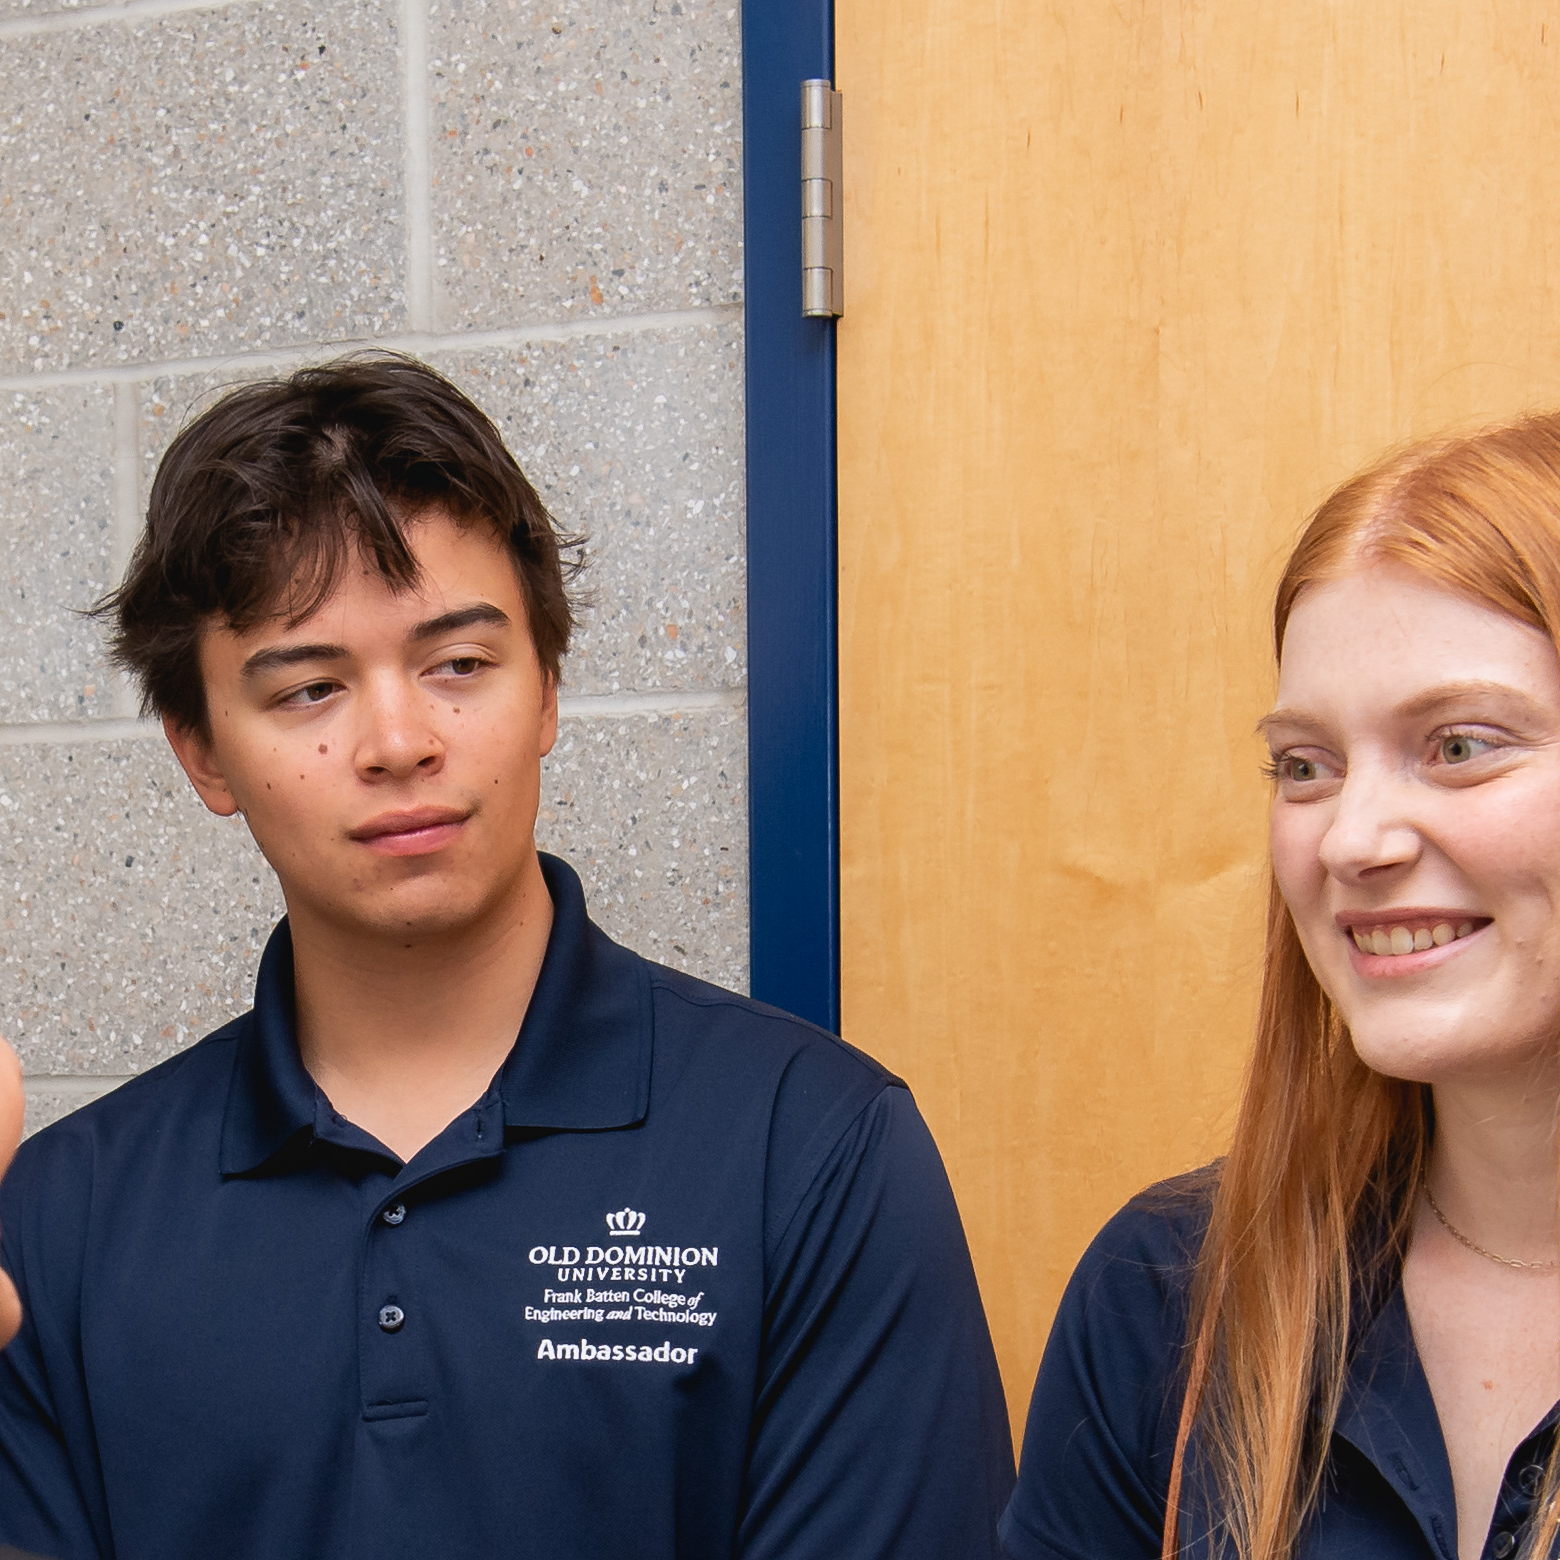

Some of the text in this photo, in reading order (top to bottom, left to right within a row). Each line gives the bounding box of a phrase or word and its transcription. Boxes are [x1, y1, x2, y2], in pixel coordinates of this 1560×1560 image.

[528, 1246, 719, 1266] OLD DOMINION
[557, 1267, 686, 1283] UNIVERSITY
[543, 1288, 704, 1310] Frank Batten College of
[524, 1306, 717, 1327] Engineering and Technology
[537, 1338, 698, 1365] Ambassador
